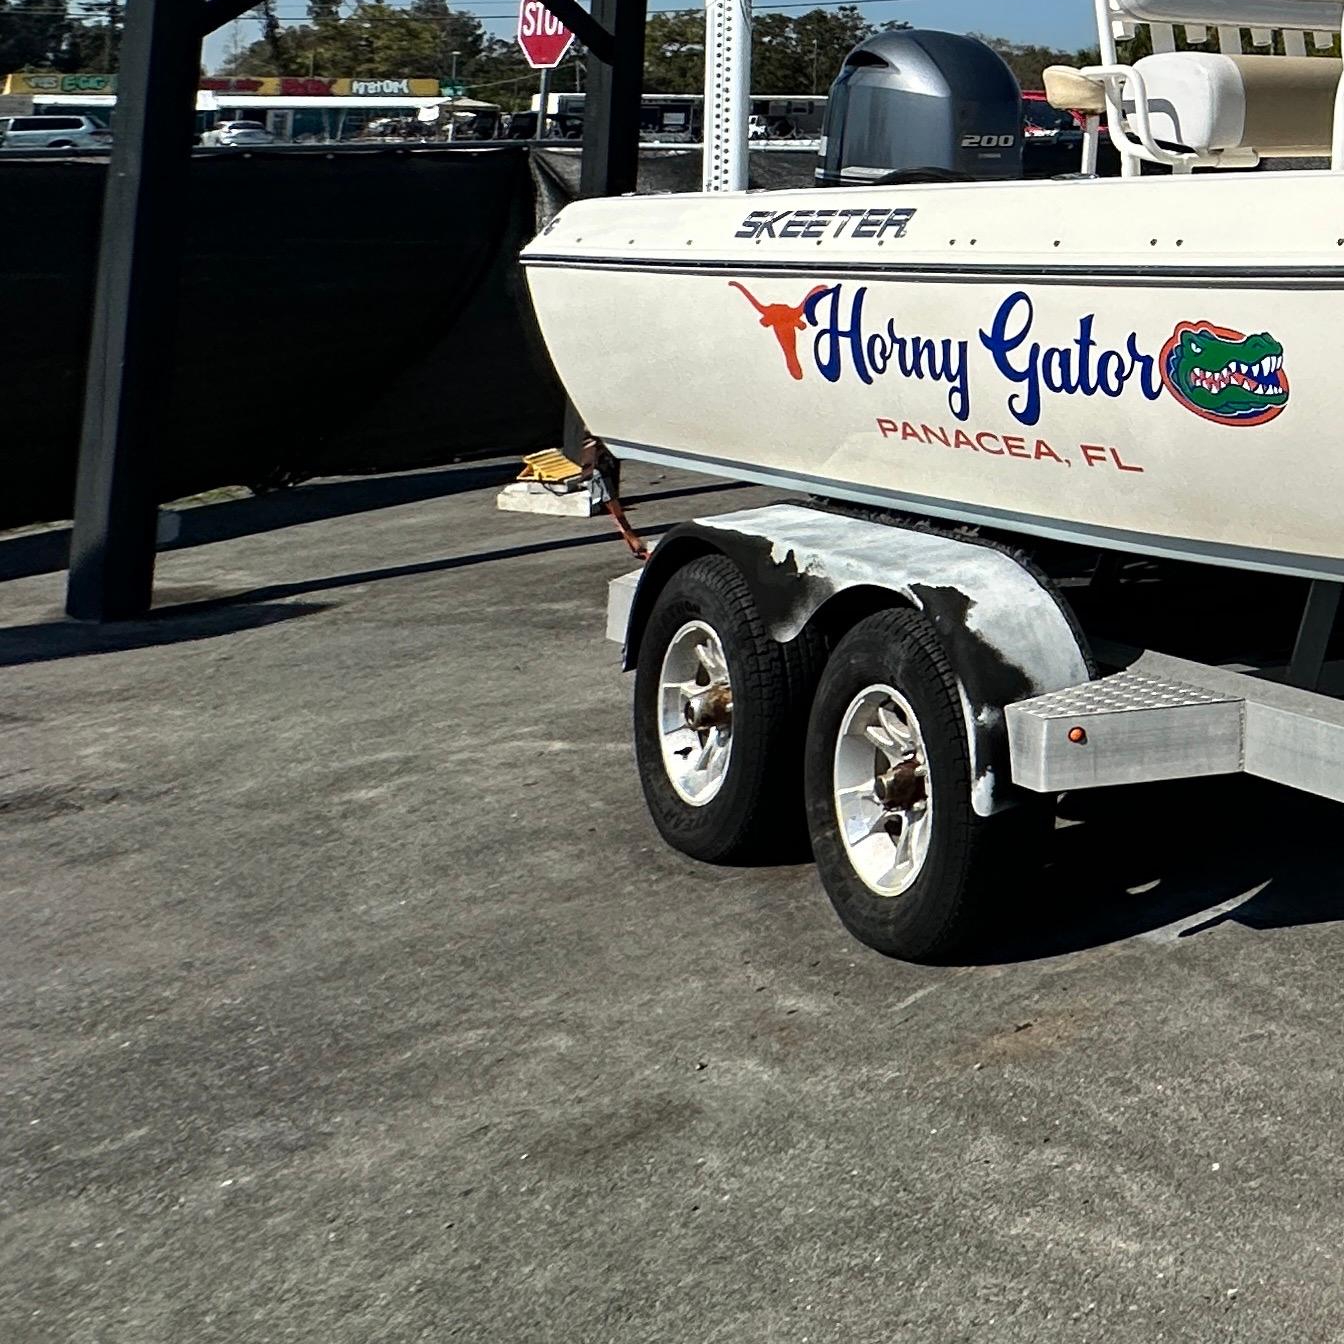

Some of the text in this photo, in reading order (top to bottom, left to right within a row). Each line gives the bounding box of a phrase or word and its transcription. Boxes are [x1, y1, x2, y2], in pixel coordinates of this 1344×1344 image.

[961, 135, 1014, 147] 200
[734, 208, 917, 238] SKEETER
[804, 284, 1162, 425] Horny Gator
[877, 419, 1144, 472] PANACEA, FL
